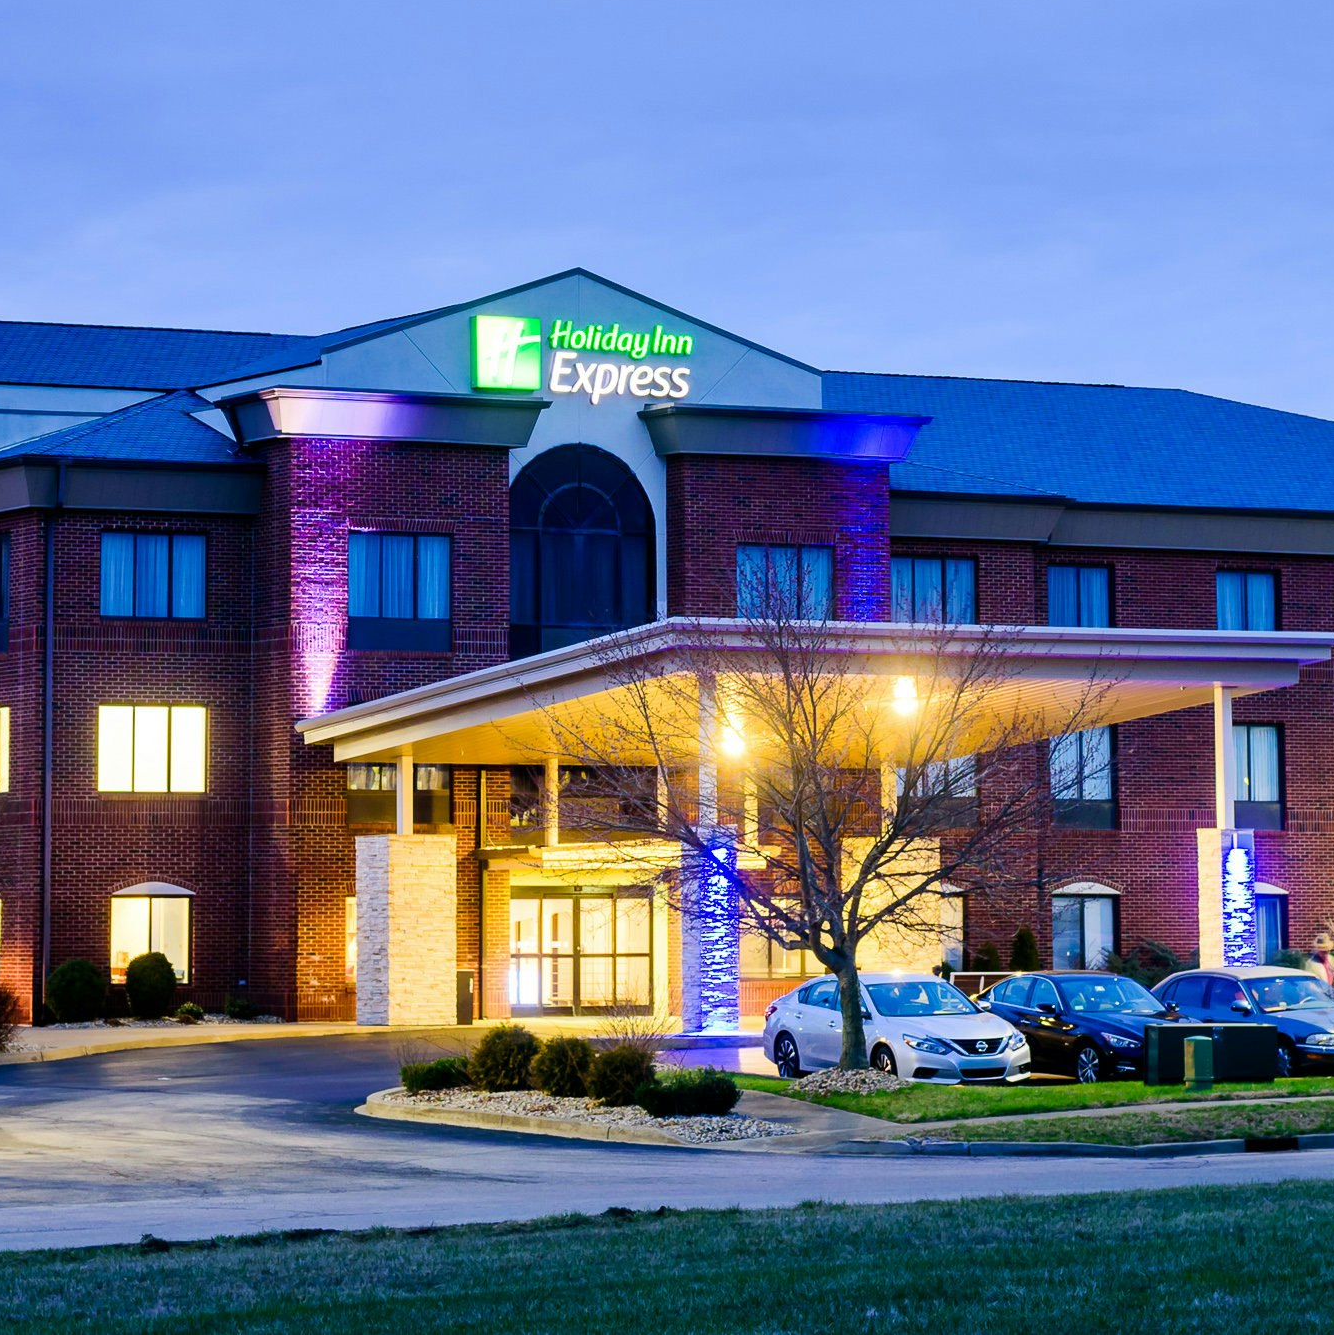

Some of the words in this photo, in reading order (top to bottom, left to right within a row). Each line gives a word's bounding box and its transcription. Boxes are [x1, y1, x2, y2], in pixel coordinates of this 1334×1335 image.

[549, 319, 650, 360] Holiday
[652, 324, 693, 355] Inn
[549, 350, 691, 405] Express
